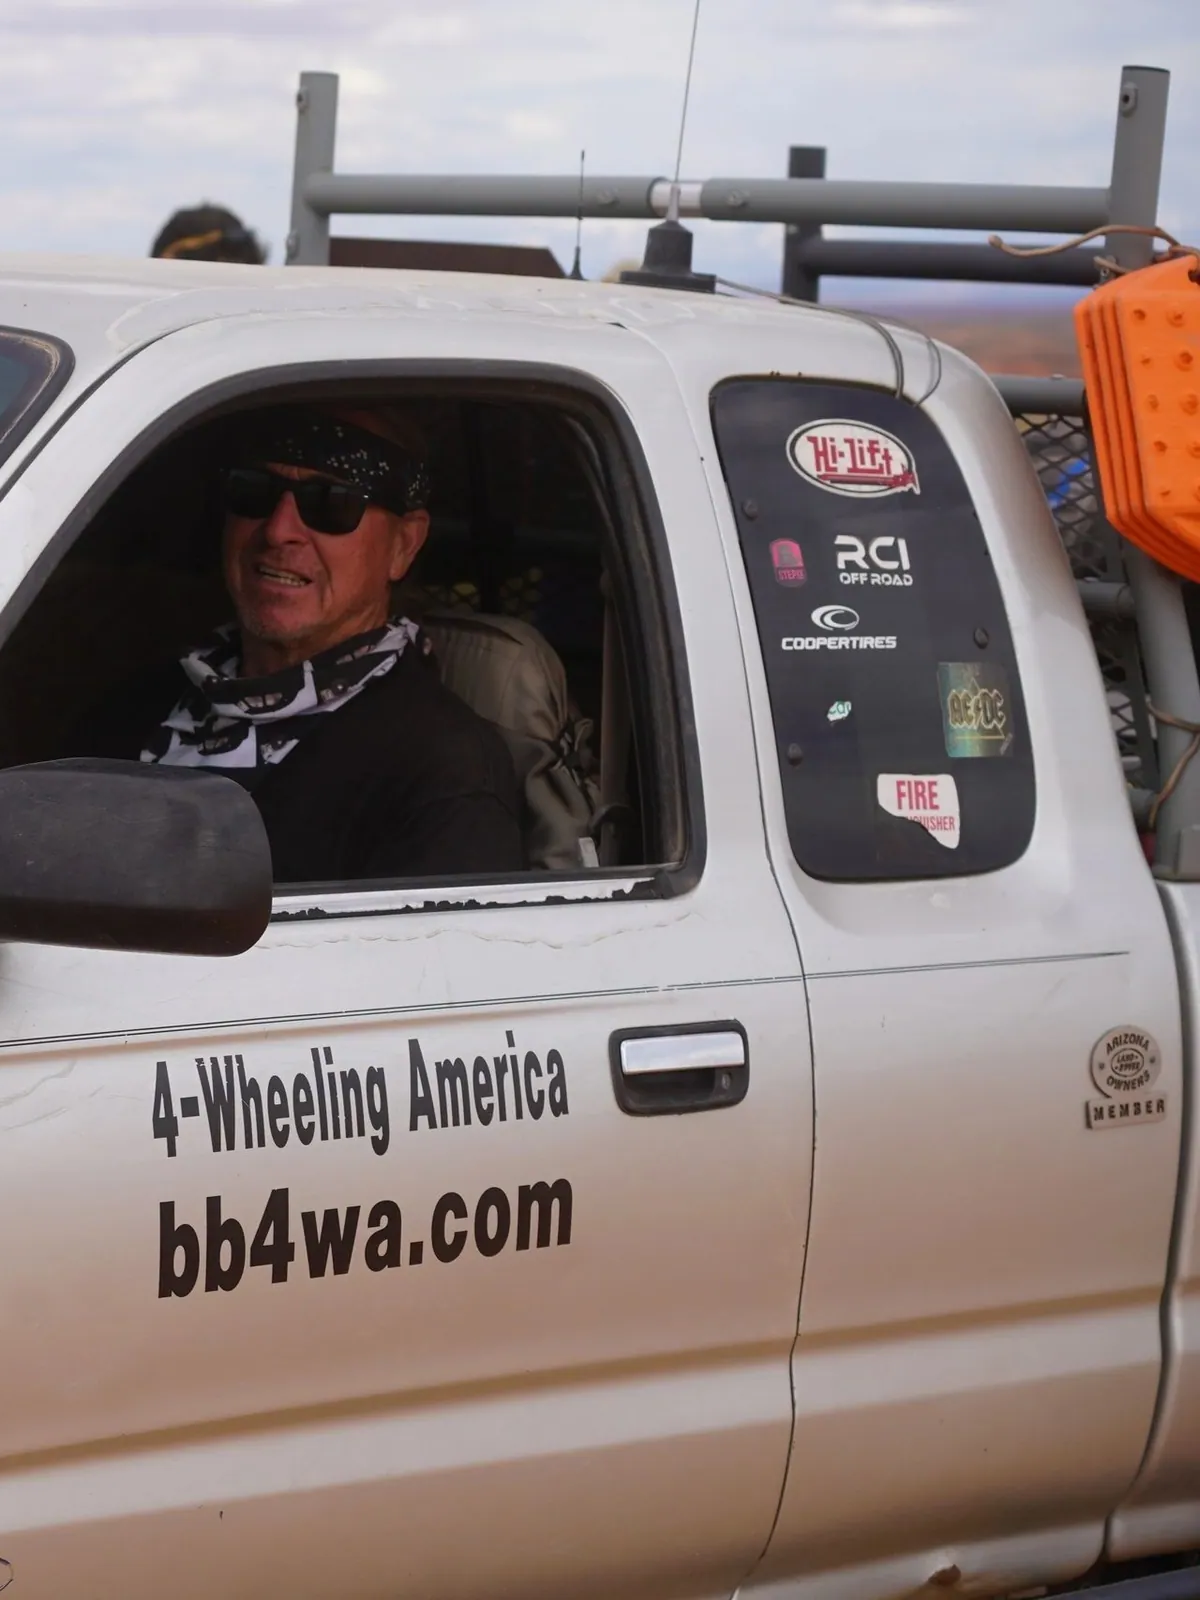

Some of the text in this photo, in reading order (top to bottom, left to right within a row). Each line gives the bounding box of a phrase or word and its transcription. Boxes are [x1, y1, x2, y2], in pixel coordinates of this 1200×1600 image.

[806, 435, 893, 475] Hi-Lift
[834, 534, 911, 571] RCI
[839, 571, 914, 587] OFF ROAD
[781, 635, 898, 650] COOPERTIRES
[896, 780, 940, 810] FIRE
[1106, 1033, 1150, 1055] ARIZONA
[1106, 1069, 1151, 1091] OWNERS
[152, 1030, 569, 1157] 4-Wheeling America
[1093, 1098, 1166, 1121] MEMBER
[158, 1178, 573, 1298] bb4wa.com
